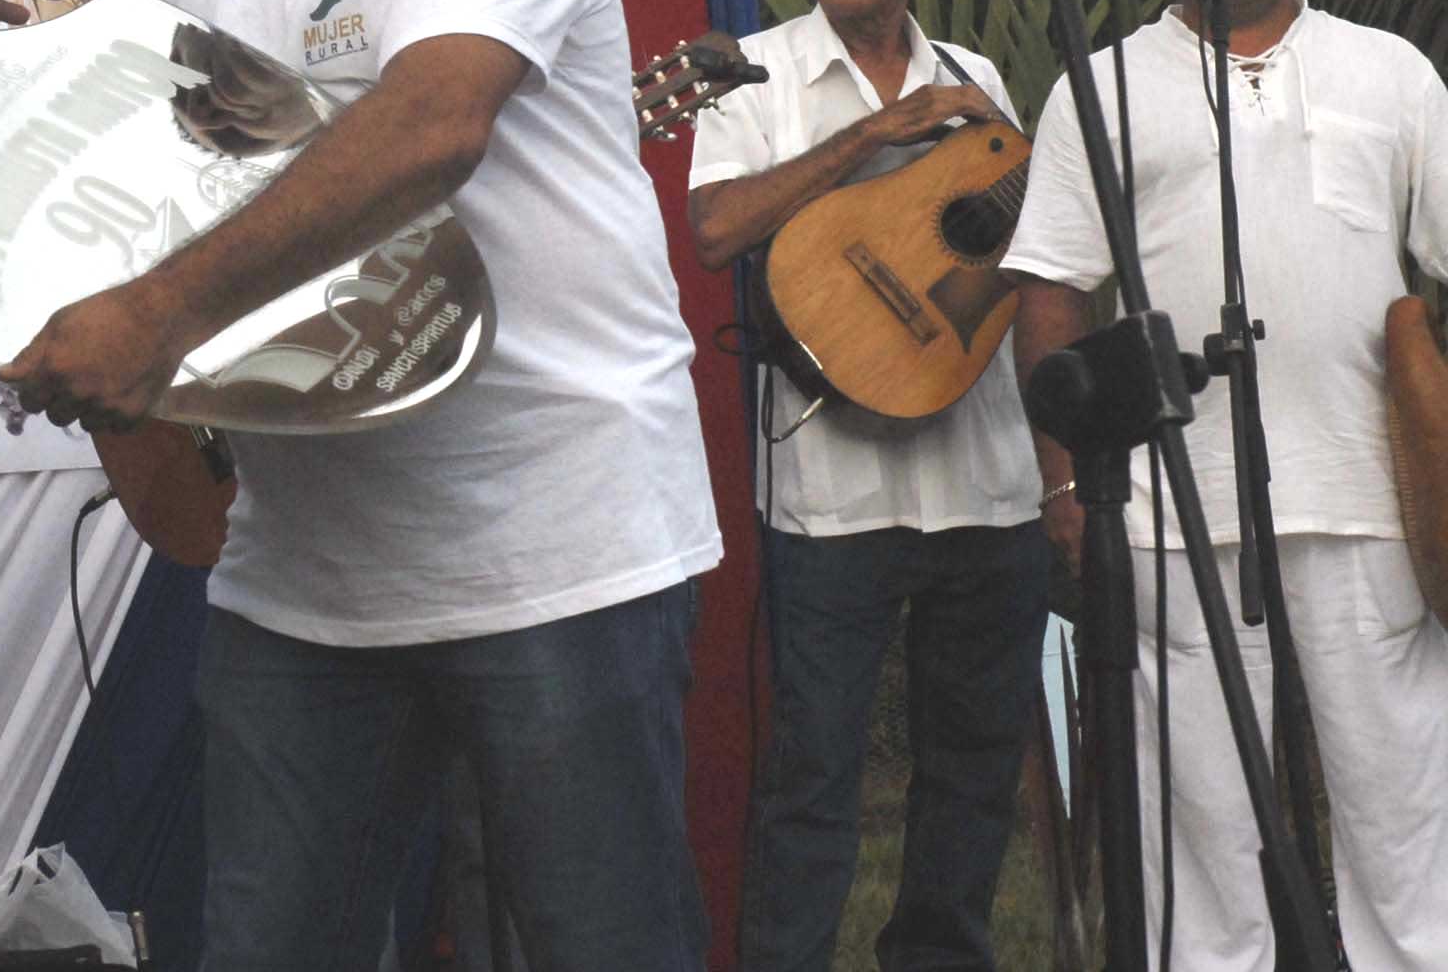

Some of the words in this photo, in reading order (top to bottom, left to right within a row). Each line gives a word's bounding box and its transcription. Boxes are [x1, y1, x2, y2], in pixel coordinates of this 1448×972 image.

[303, 14, 365, 49] MUJER
[305, 35, 369, 62] RURAL
[45, 175, 158, 278] 90
